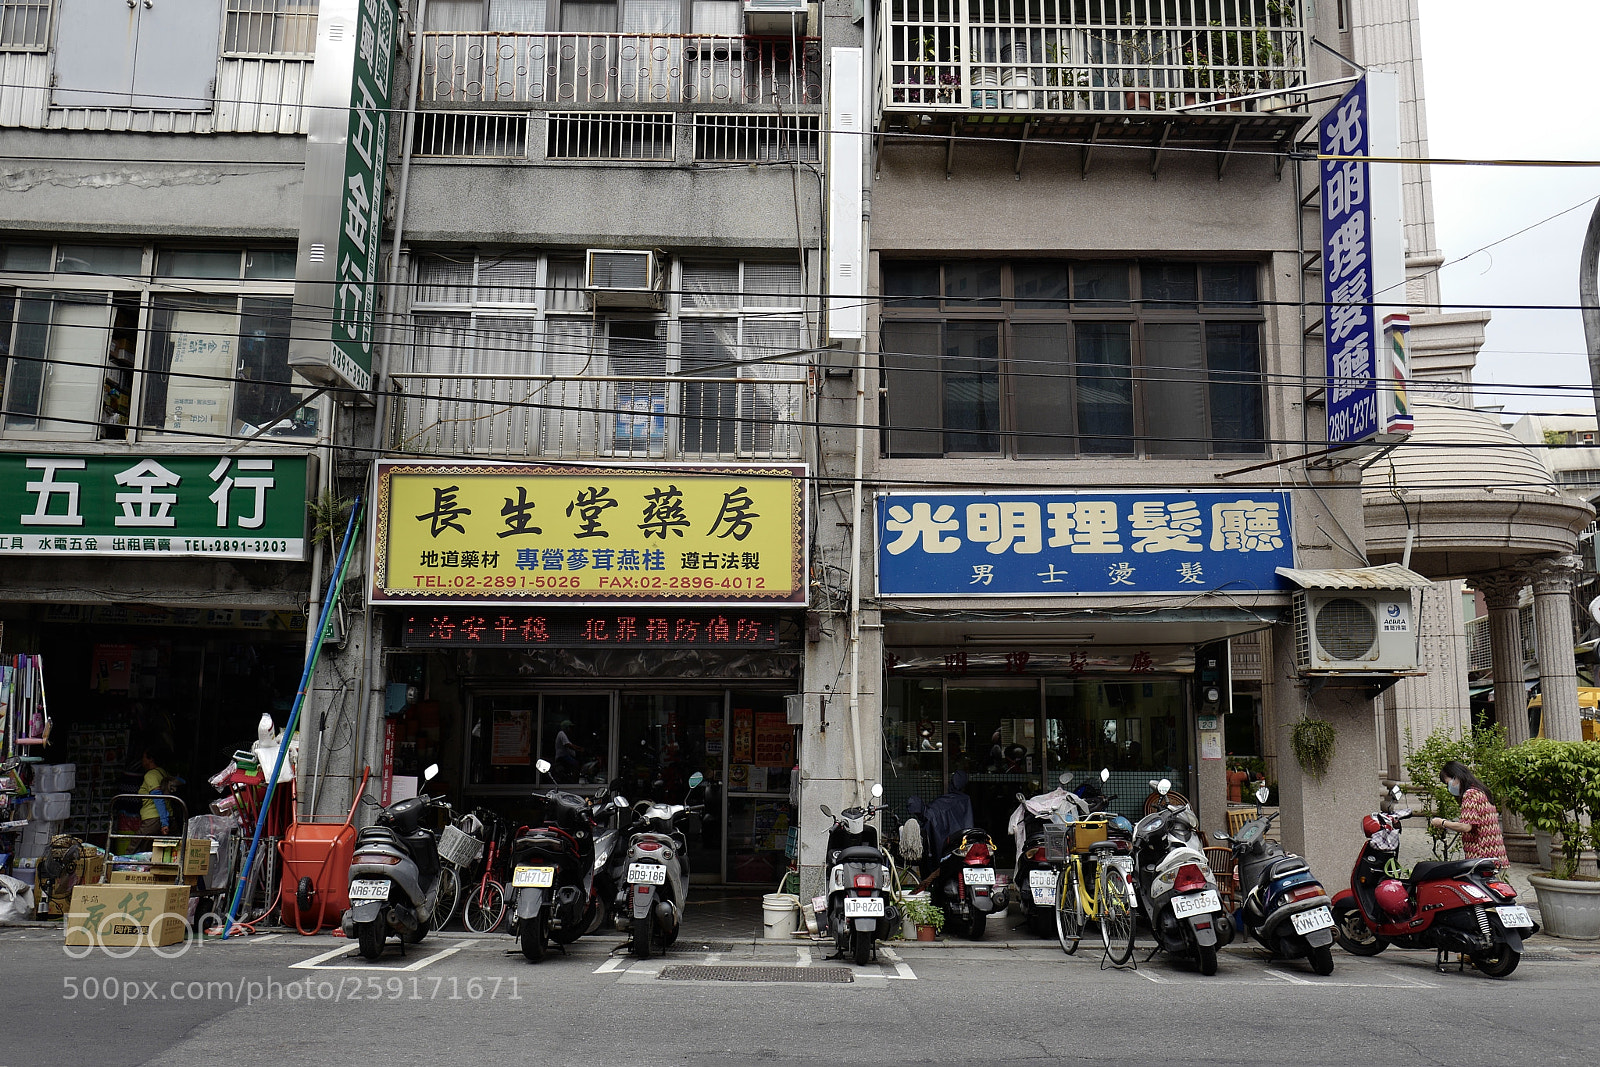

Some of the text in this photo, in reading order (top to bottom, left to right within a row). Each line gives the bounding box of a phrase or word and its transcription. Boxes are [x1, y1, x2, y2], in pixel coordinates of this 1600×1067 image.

[1326, 95, 1370, 403] 光明理髮廳
[332, 346, 369, 391] 2891-3203
[1329, 393, 1376, 442] 2891-2374
[415, 485, 760, 541] 長生堂藥房
[886, 500, 1284, 555] 光明理髮廳
[38, 537, 98, 551] 水電五金
[112, 538, 171, 552] 出租買賣
[184, 539, 287, 553] TEL:2891-3203
[420, 548, 760, 571] 地道藥材 專營蔘茸燕桂 遵古法製
[413, 575, 766, 589] TEL:02-2891-5026 FAX:02-2896-4012
[1202, 721, 1214, 729] 23
[1175, 896, 1218, 914] AES-0396
